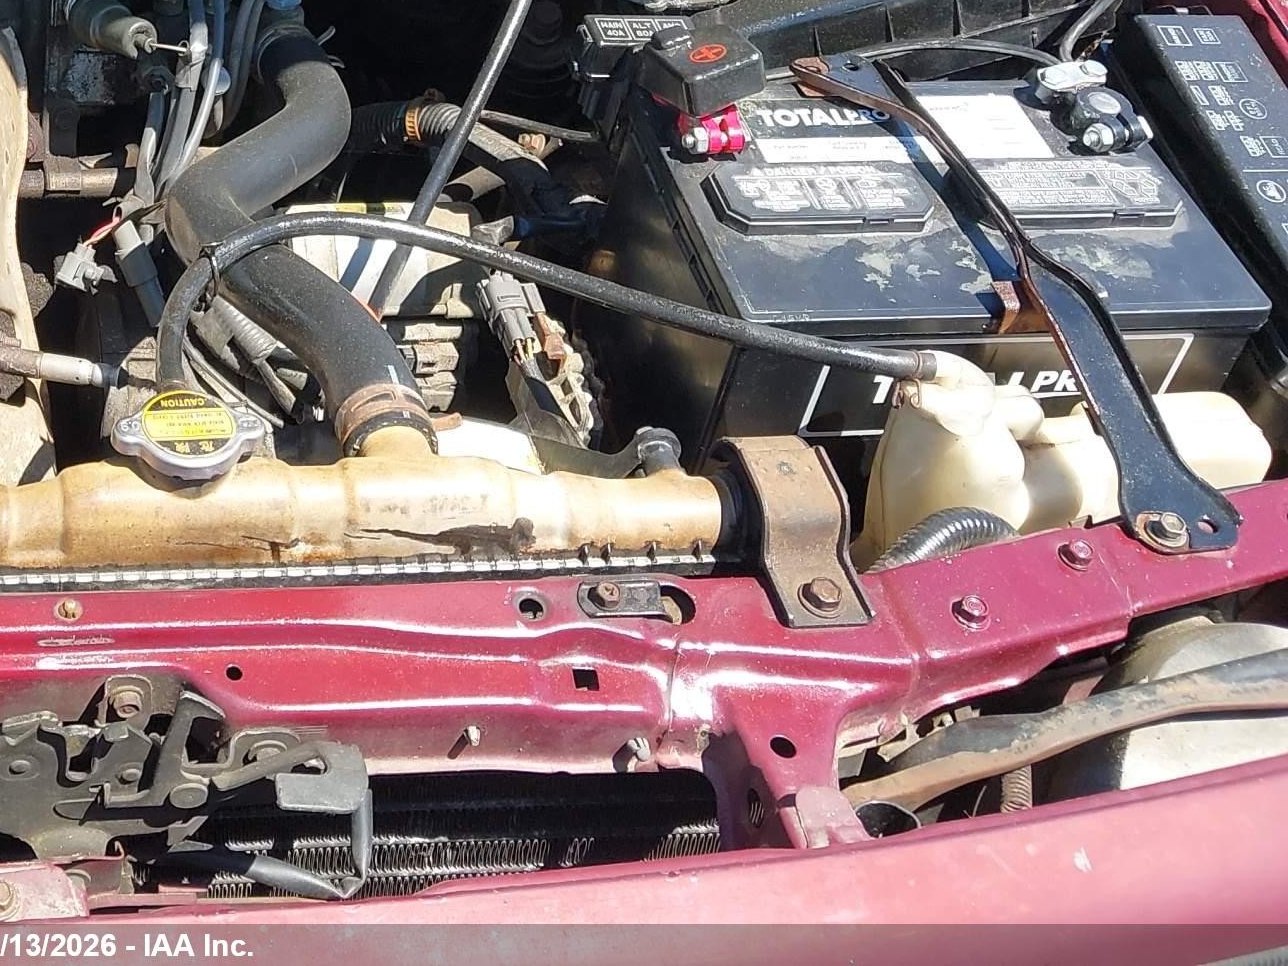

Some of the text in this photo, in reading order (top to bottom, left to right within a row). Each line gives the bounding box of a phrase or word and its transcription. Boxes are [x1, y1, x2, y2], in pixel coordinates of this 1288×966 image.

[600, 20, 624, 30] MAIN
[631, 22, 652, 30] ALT
[755, 108, 891, 127] TOTALPRO
[160, 398, 206, 409] CAUTION
